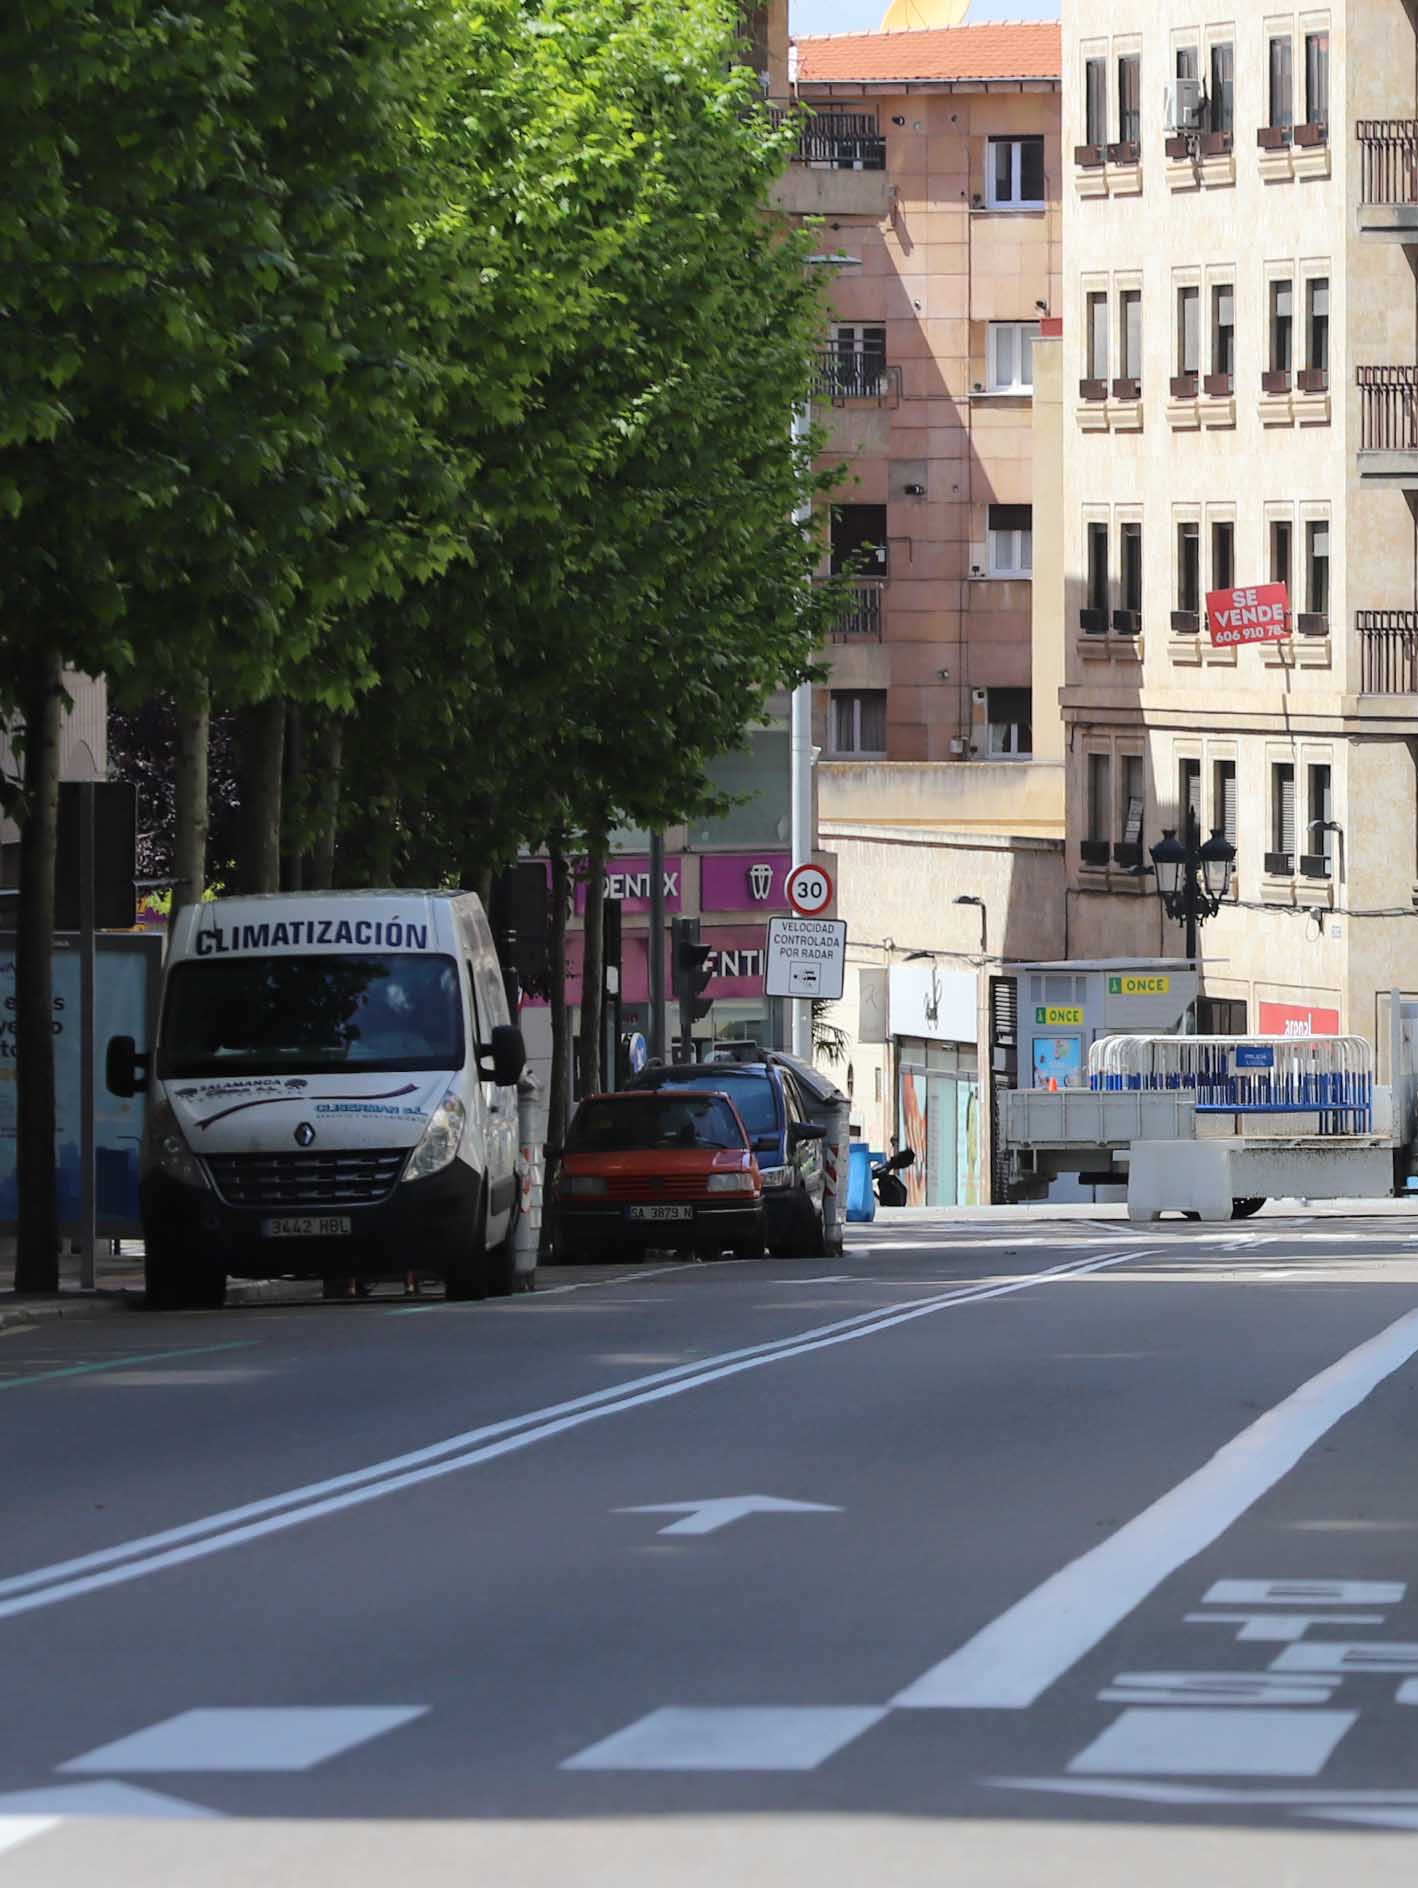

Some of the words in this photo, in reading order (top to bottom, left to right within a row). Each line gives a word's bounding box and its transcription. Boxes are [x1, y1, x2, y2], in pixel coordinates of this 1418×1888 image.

[1232, 589, 1258, 607] SE
[1214, 603, 1284, 626] VENDE
[1216, 630, 1240, 642] 606
[1243, 627, 1264, 639] 910
[798, 882, 822, 898] 30
[782, 922, 834, 934] VELOCIDAD
[196, 916, 427, 956] CLIMATIZACIÓN
[774, 934, 840, 947] CONTROLADA
[780, 947, 800, 957] POR
[802, 948, 834, 960] RADAR
[1126, 979, 1164, 991] ONCE
[1049, 1010, 1079, 1022] ONCE
[632, 1207, 645, 1218] SA
[651, 1207, 679, 1218] 3879
[684, 1207, 692, 1217] N
